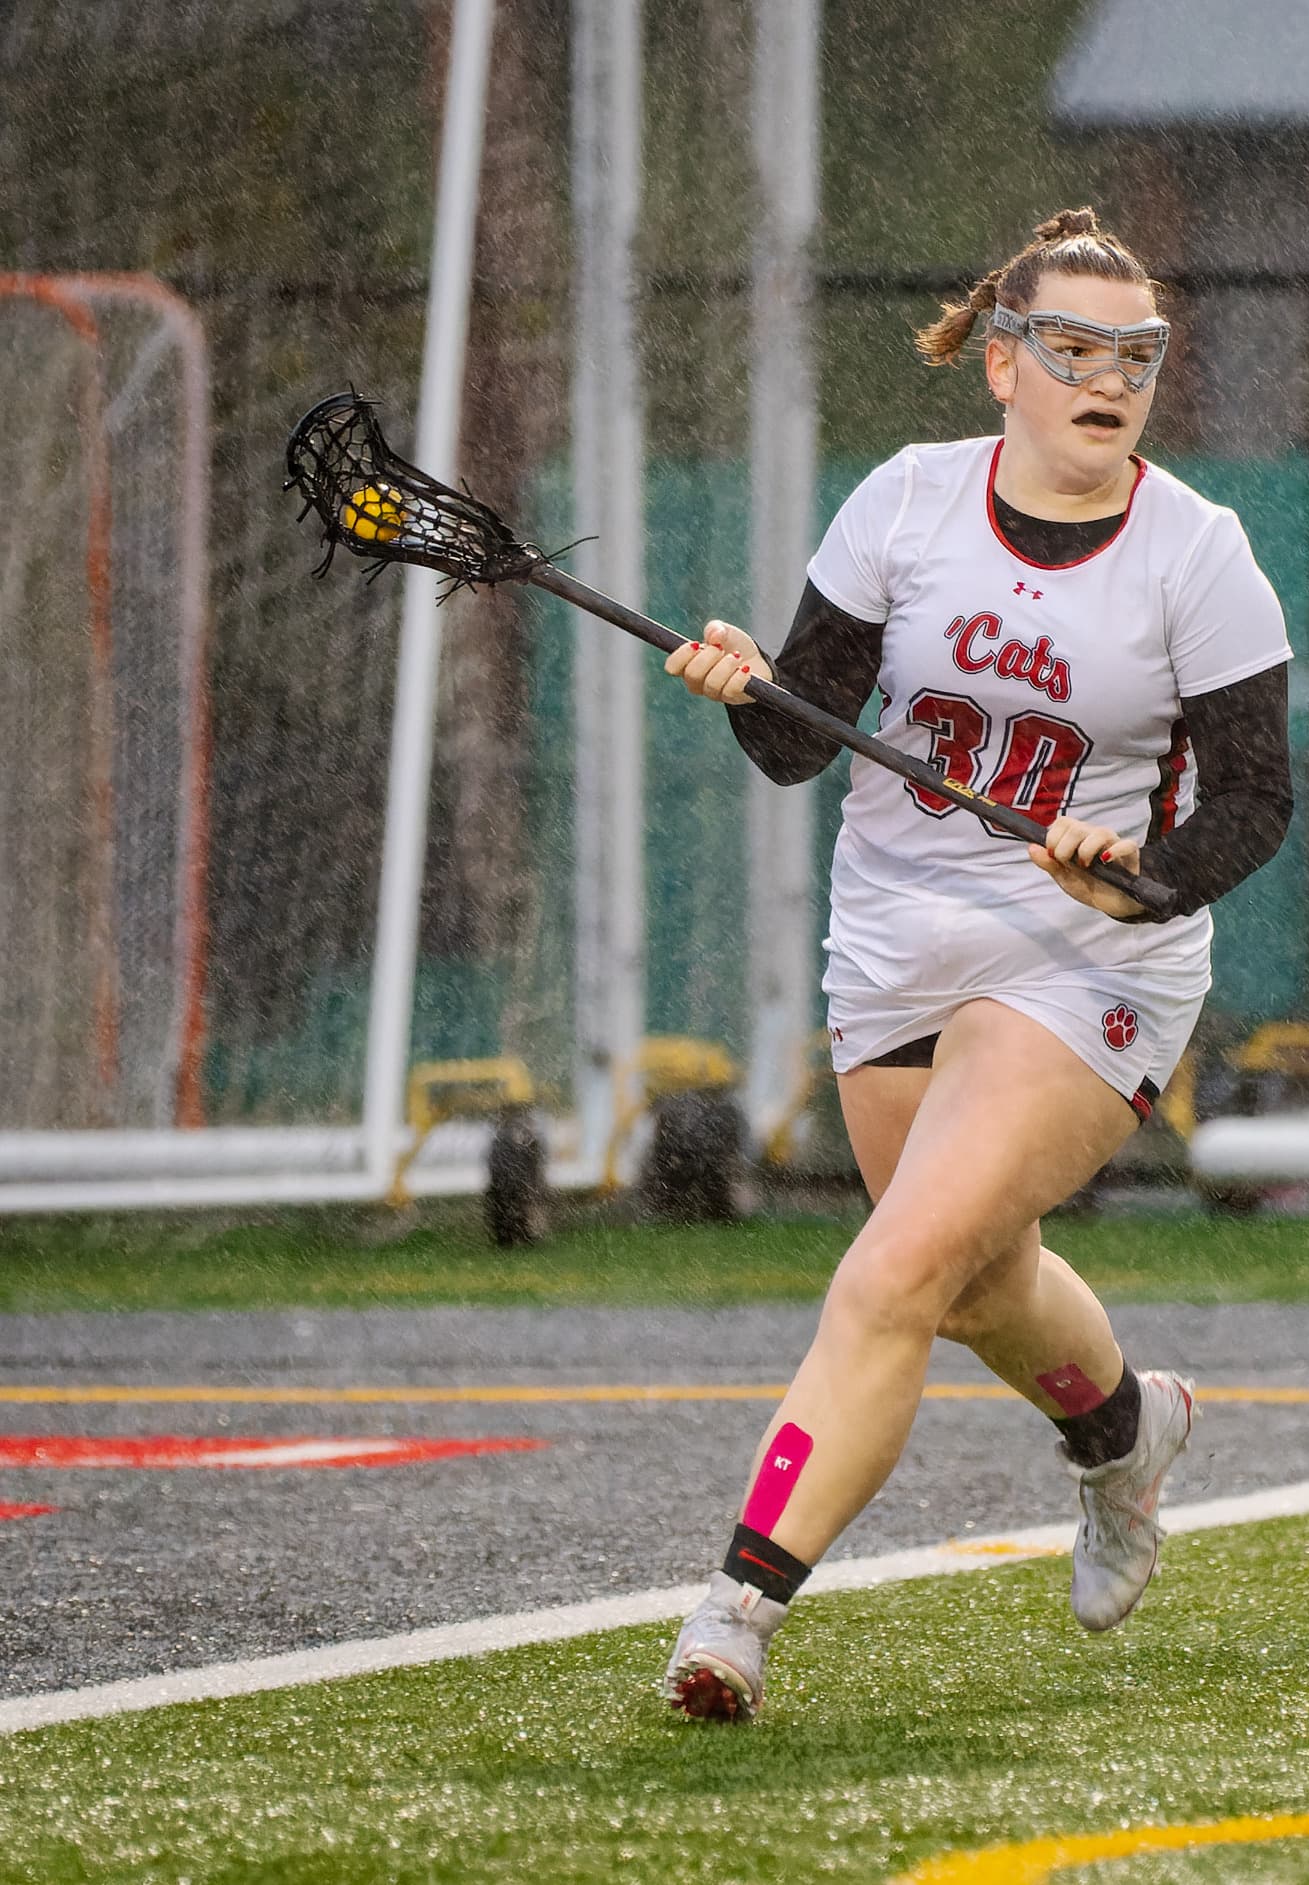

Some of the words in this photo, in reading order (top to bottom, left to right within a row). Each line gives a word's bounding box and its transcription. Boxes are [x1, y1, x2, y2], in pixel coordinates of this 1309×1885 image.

[944, 611, 1072, 702] 'Cats
[904, 687, 1094, 841] 30
[774, 1456, 792, 1471] KT
